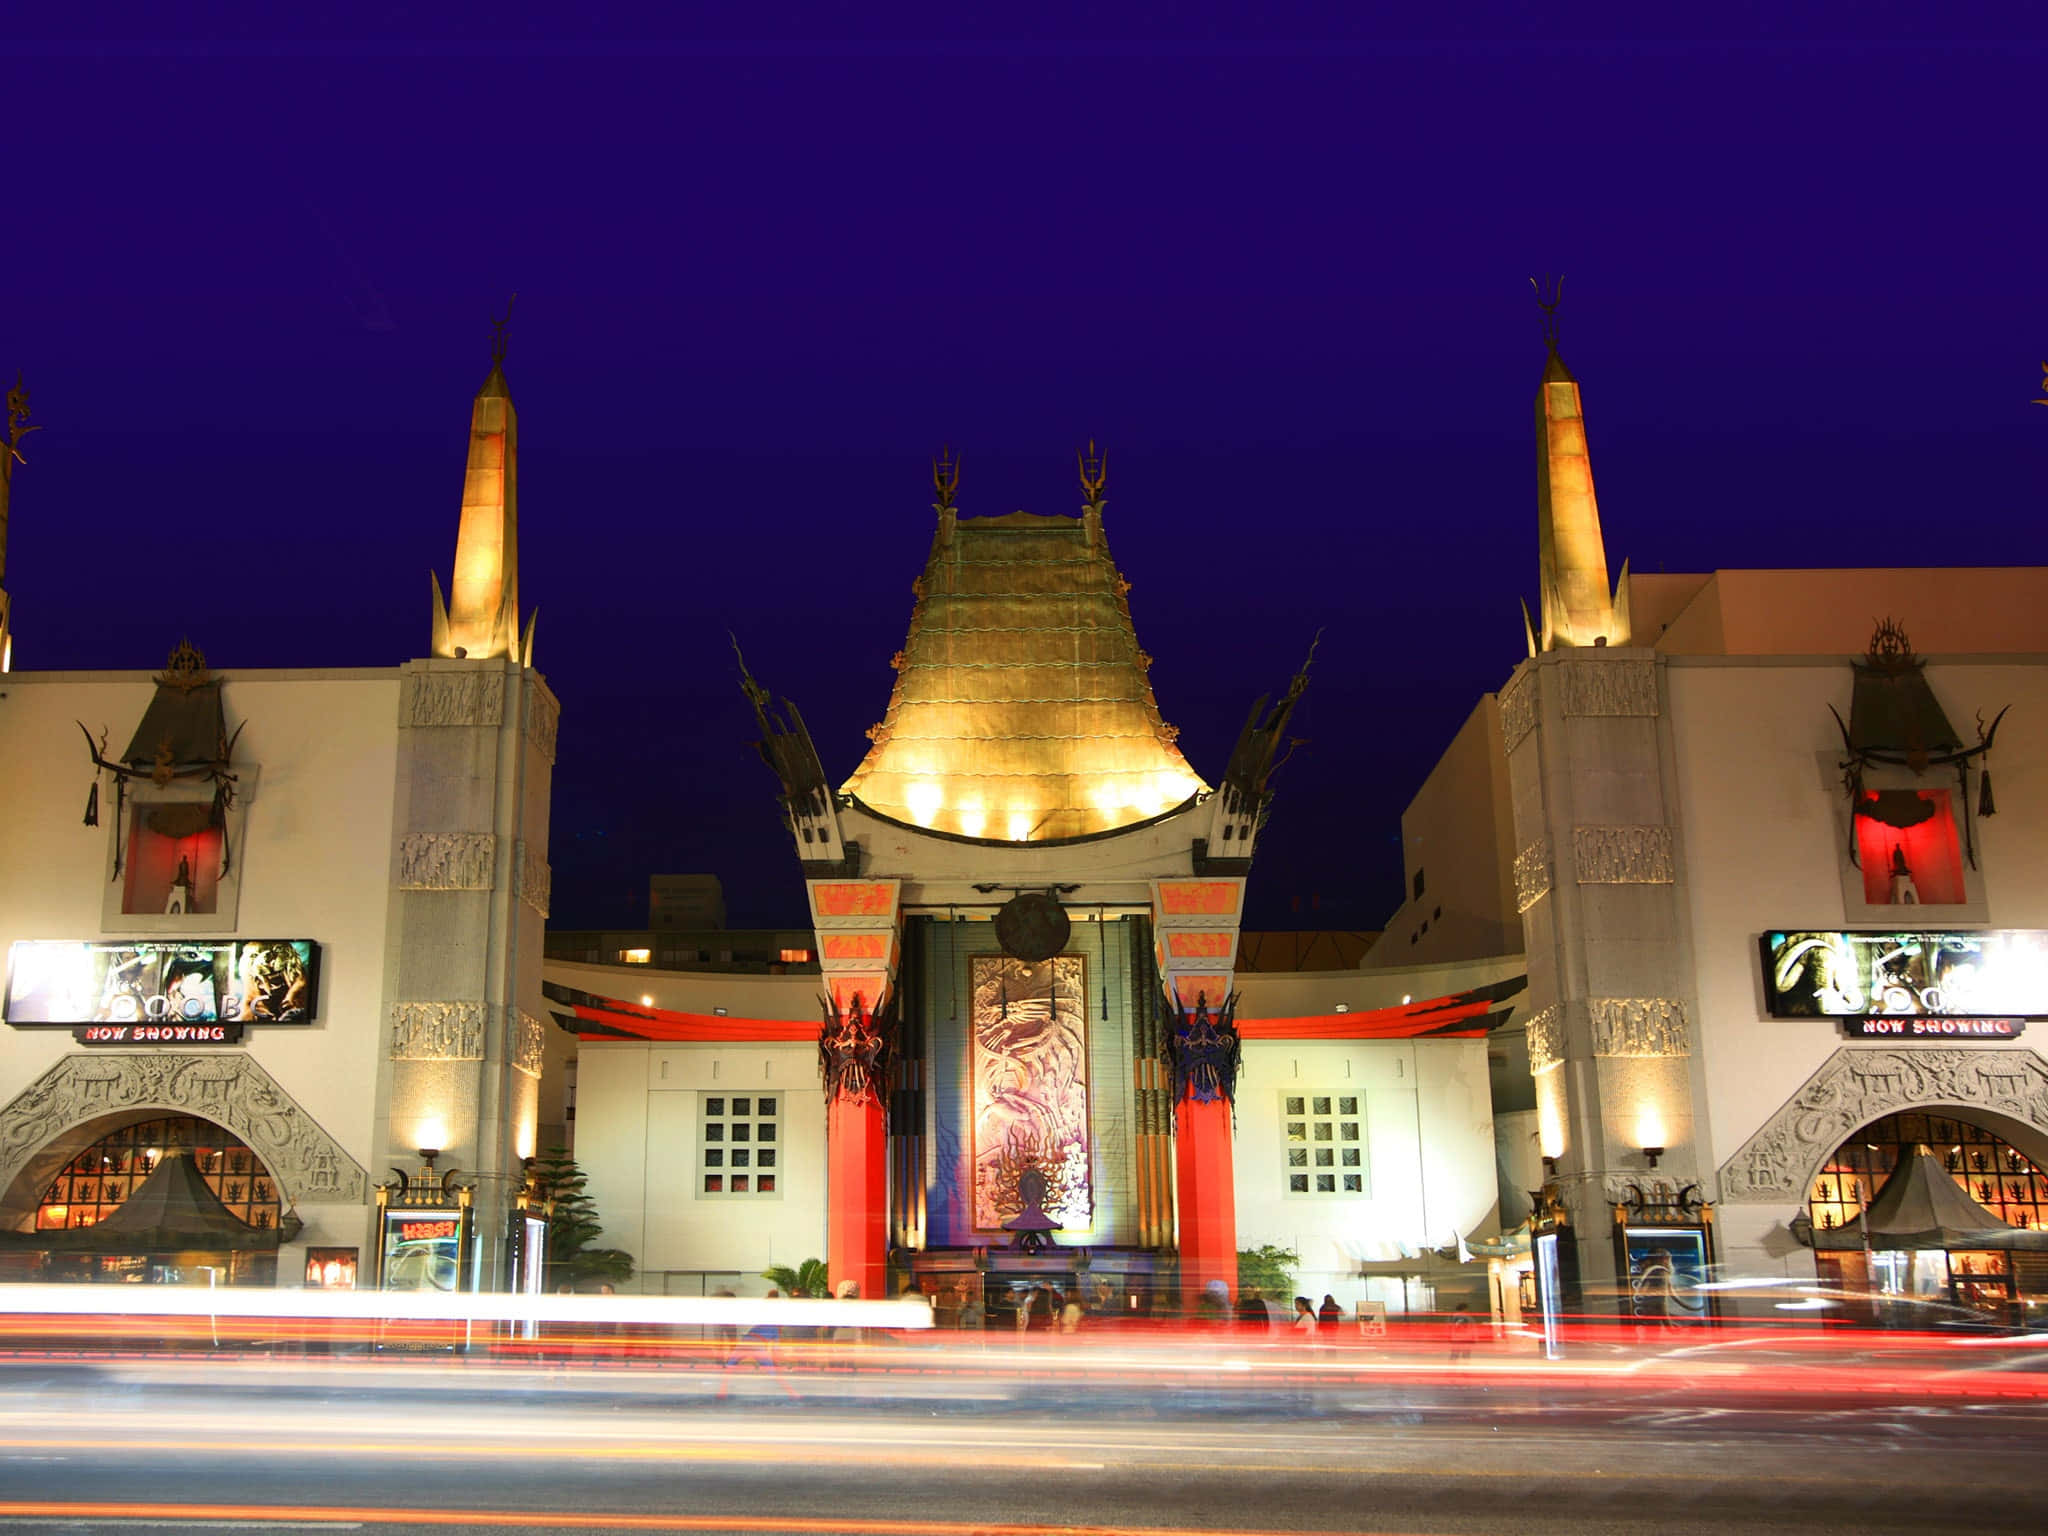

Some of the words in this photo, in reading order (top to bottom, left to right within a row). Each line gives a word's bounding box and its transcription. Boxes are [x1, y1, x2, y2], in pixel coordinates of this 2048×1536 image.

[86, 1026, 127, 1040] NOW
[132, 1026, 225, 1040] SHOWING
[1863, 1019, 1906, 1034] NOW
[1912, 1019, 2012, 1034] SHOWING
